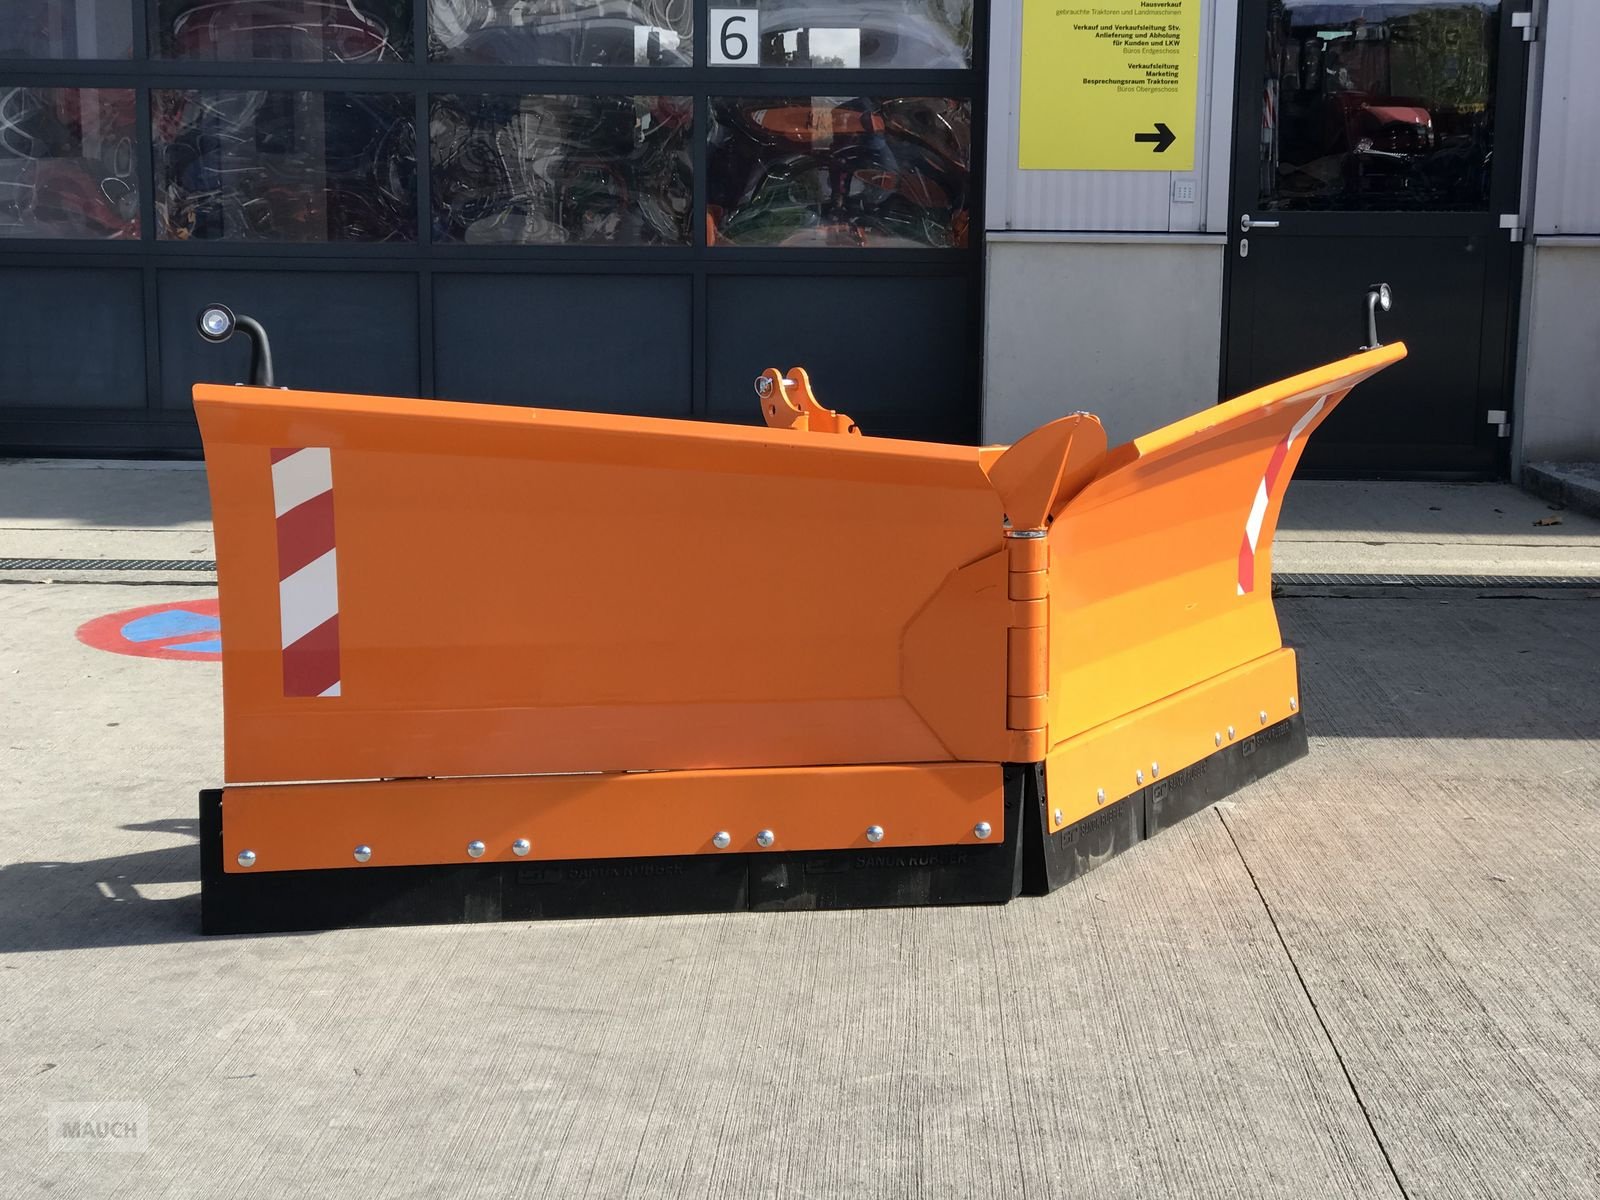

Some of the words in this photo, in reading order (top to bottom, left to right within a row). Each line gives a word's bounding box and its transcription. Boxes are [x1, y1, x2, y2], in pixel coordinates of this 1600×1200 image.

[1055, 8, 1091, 16] gebrauchte
[1114, 24, 1166, 32] Verkaufsleitung
[720, 15, 748, 60] 6
[1095, 32, 1133, 40] Anlieferung
[1149, 32, 1180, 40] Abholung
[1112, 39, 1123, 47] für
[1141, 47, 1180, 55] Erdgeschoss
[1127, 63, 1179, 71] Verkaufsleitung
[1145, 70, 1179, 78] Marketing
[1082, 78, 1146, 86] Besprechungsraum
[1135, 86, 1179, 94] Obergeschoss
